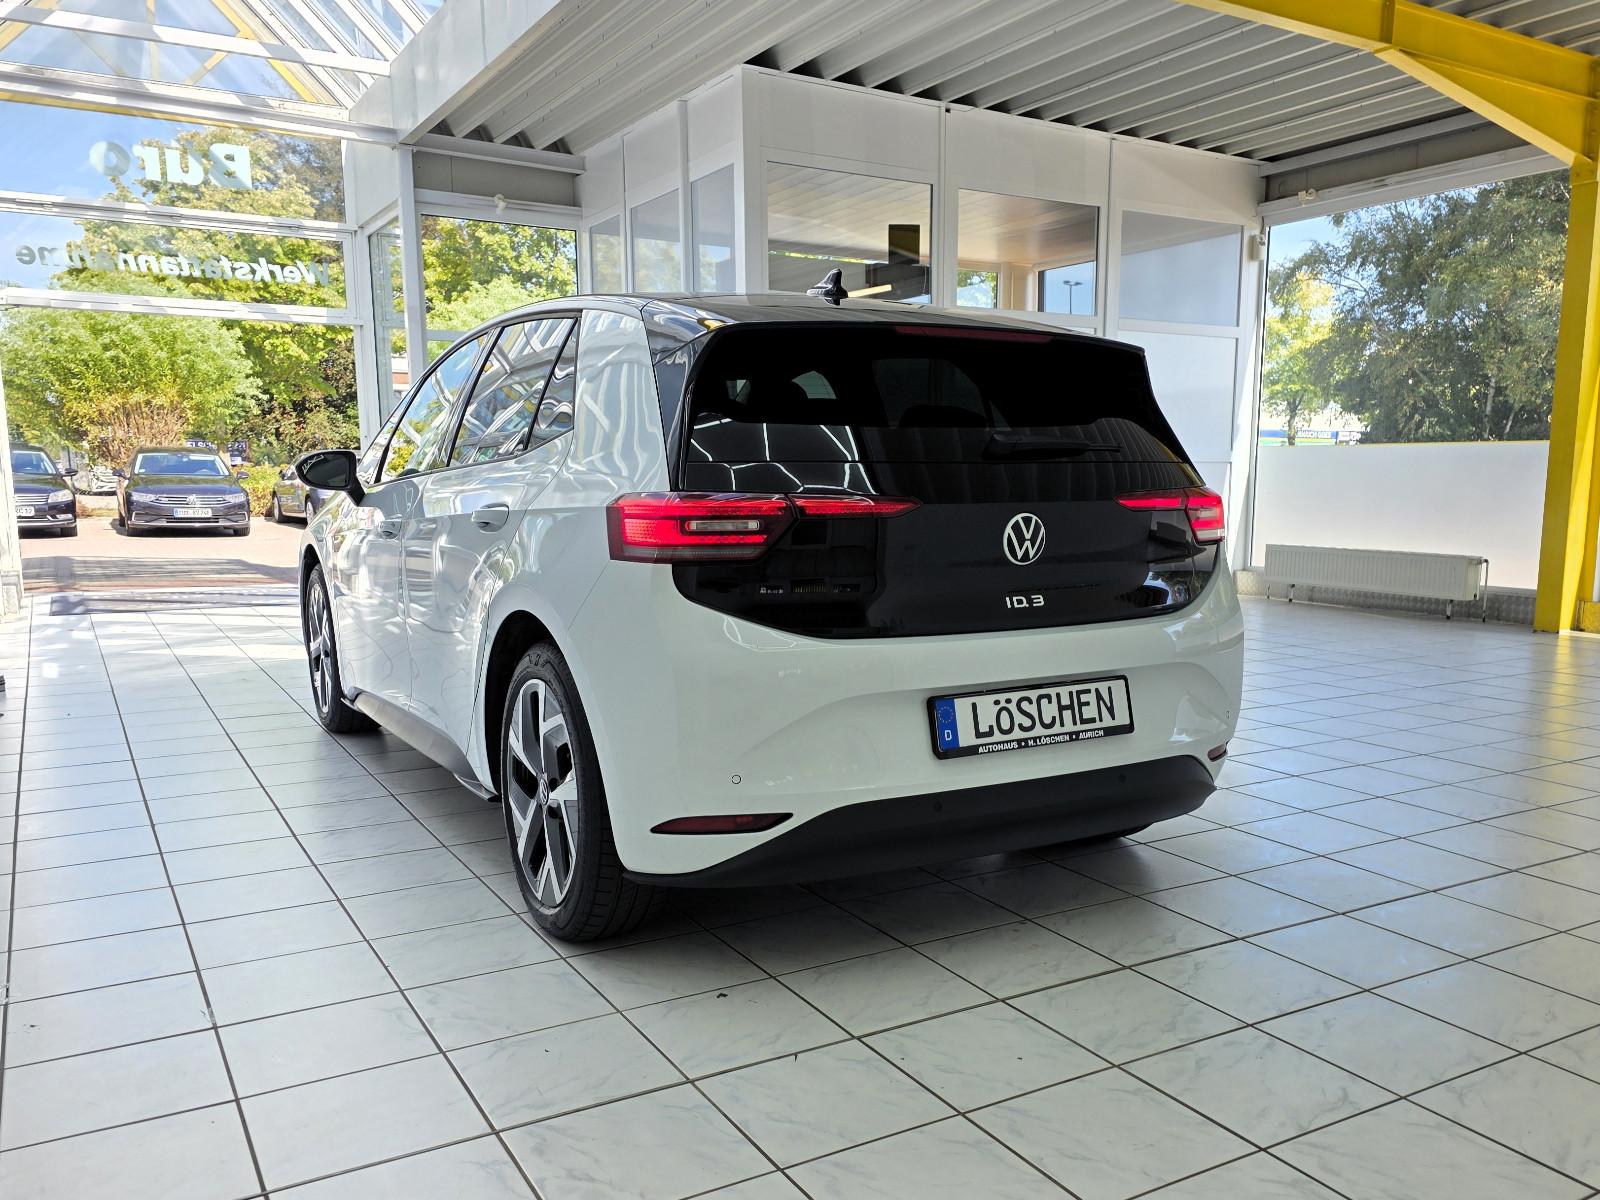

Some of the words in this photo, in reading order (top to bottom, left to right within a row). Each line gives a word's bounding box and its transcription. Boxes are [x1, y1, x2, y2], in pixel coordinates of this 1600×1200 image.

[971, 686, 1116, 739] LÖSCHEN
[944, 730, 952, 740] D
[978, 741, 1019, 754] AUTOHAUS
[1078, 729, 1104, 740] AURICH
